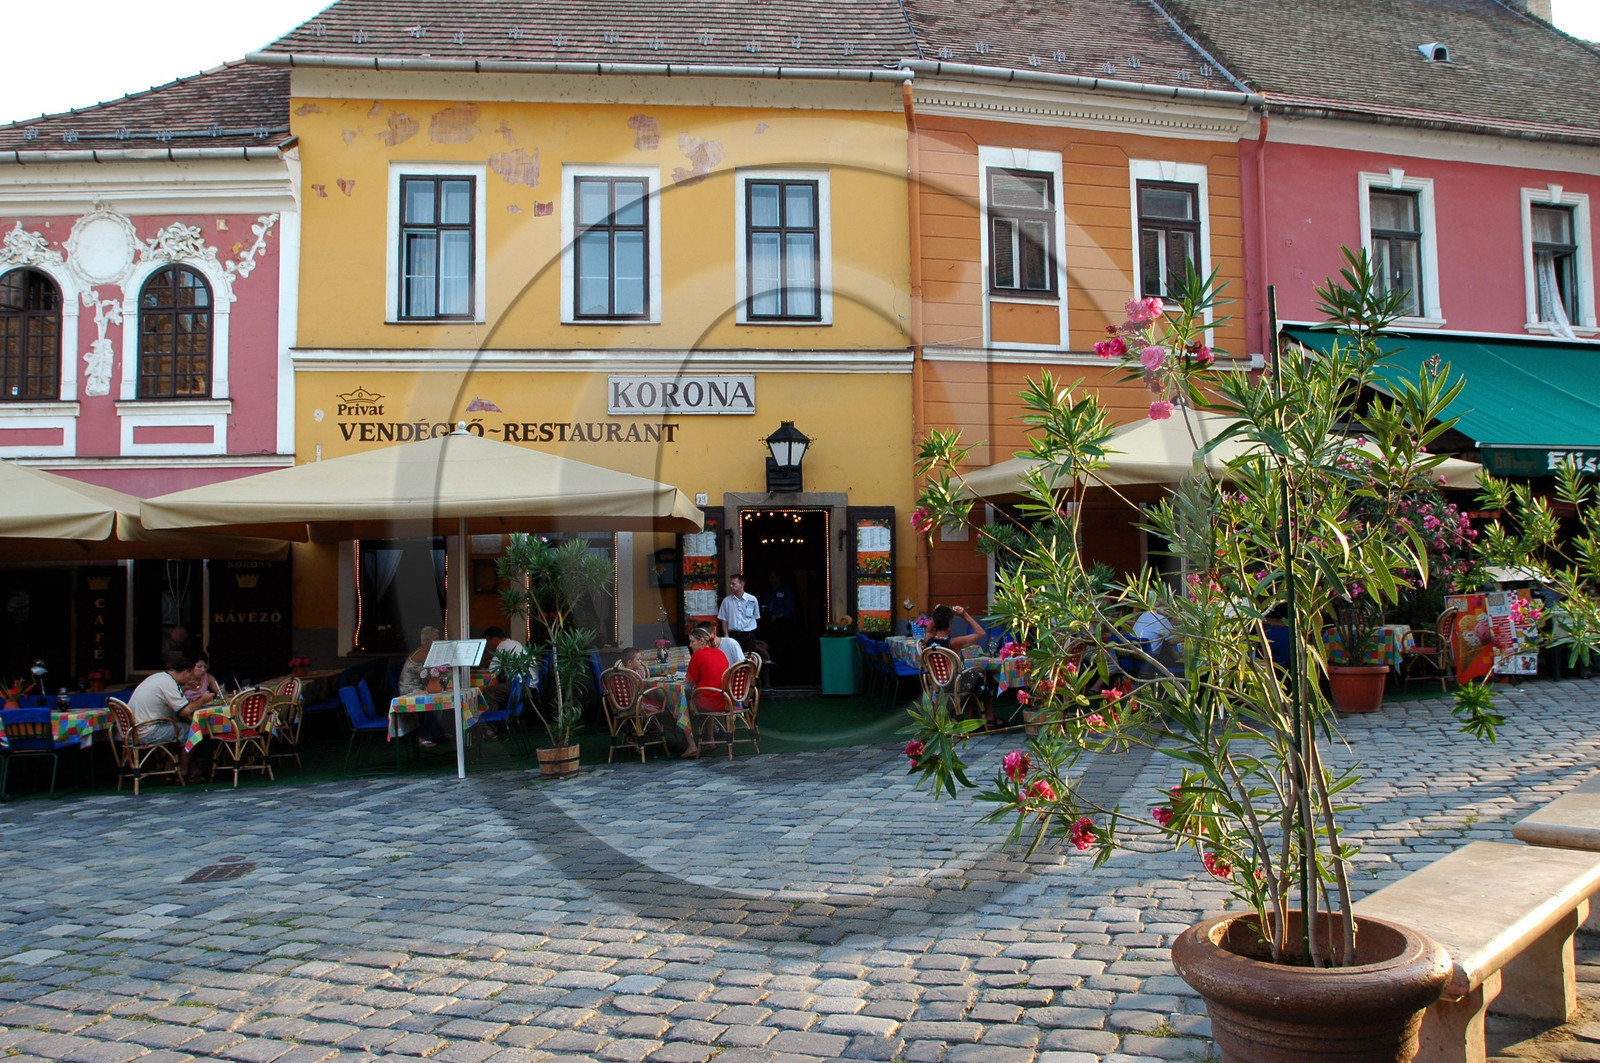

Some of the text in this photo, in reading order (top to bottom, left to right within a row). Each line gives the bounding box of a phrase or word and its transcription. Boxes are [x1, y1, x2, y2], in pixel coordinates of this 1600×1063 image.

[613, 381, 754, 408] KORONA
[337, 403, 385, 416] Privat
[1547, 451, 1600, 473] Elis
[227, 561, 272, 569] KORONA
[214, 609, 282, 624] KÁVÉZÓ
